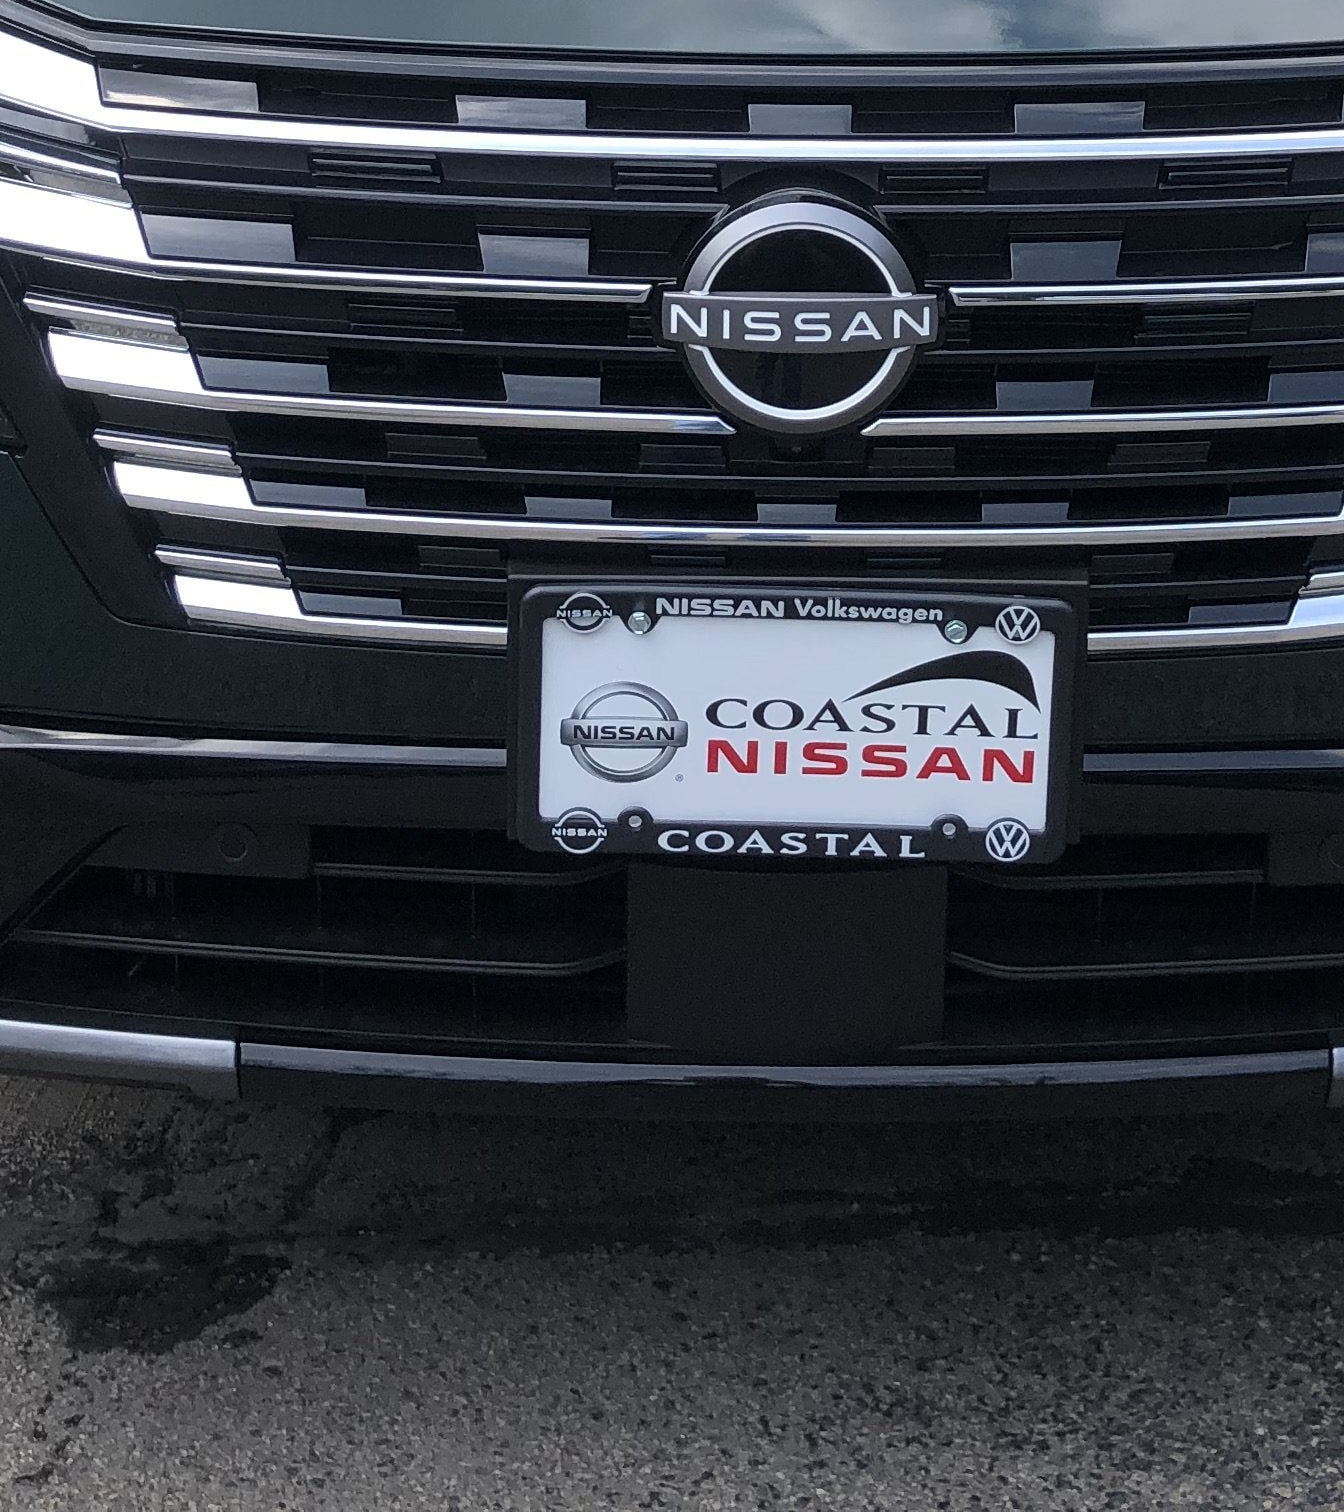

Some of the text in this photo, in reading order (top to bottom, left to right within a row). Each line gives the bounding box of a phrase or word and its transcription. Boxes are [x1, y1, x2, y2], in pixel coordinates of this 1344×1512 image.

[670, 303, 930, 343] NISSAN
[557, 606, 614, 620] NISSAN
[655, 597, 944, 625] NISSAN Volkswagen
[573, 722, 676, 742] NISSAN
[705, 697, 1039, 741] COASTAL
[706, 739, 1036, 784] NISSAN
[551, 825, 608, 839] NISSAN
[657, 828, 926, 859] COASTAL
